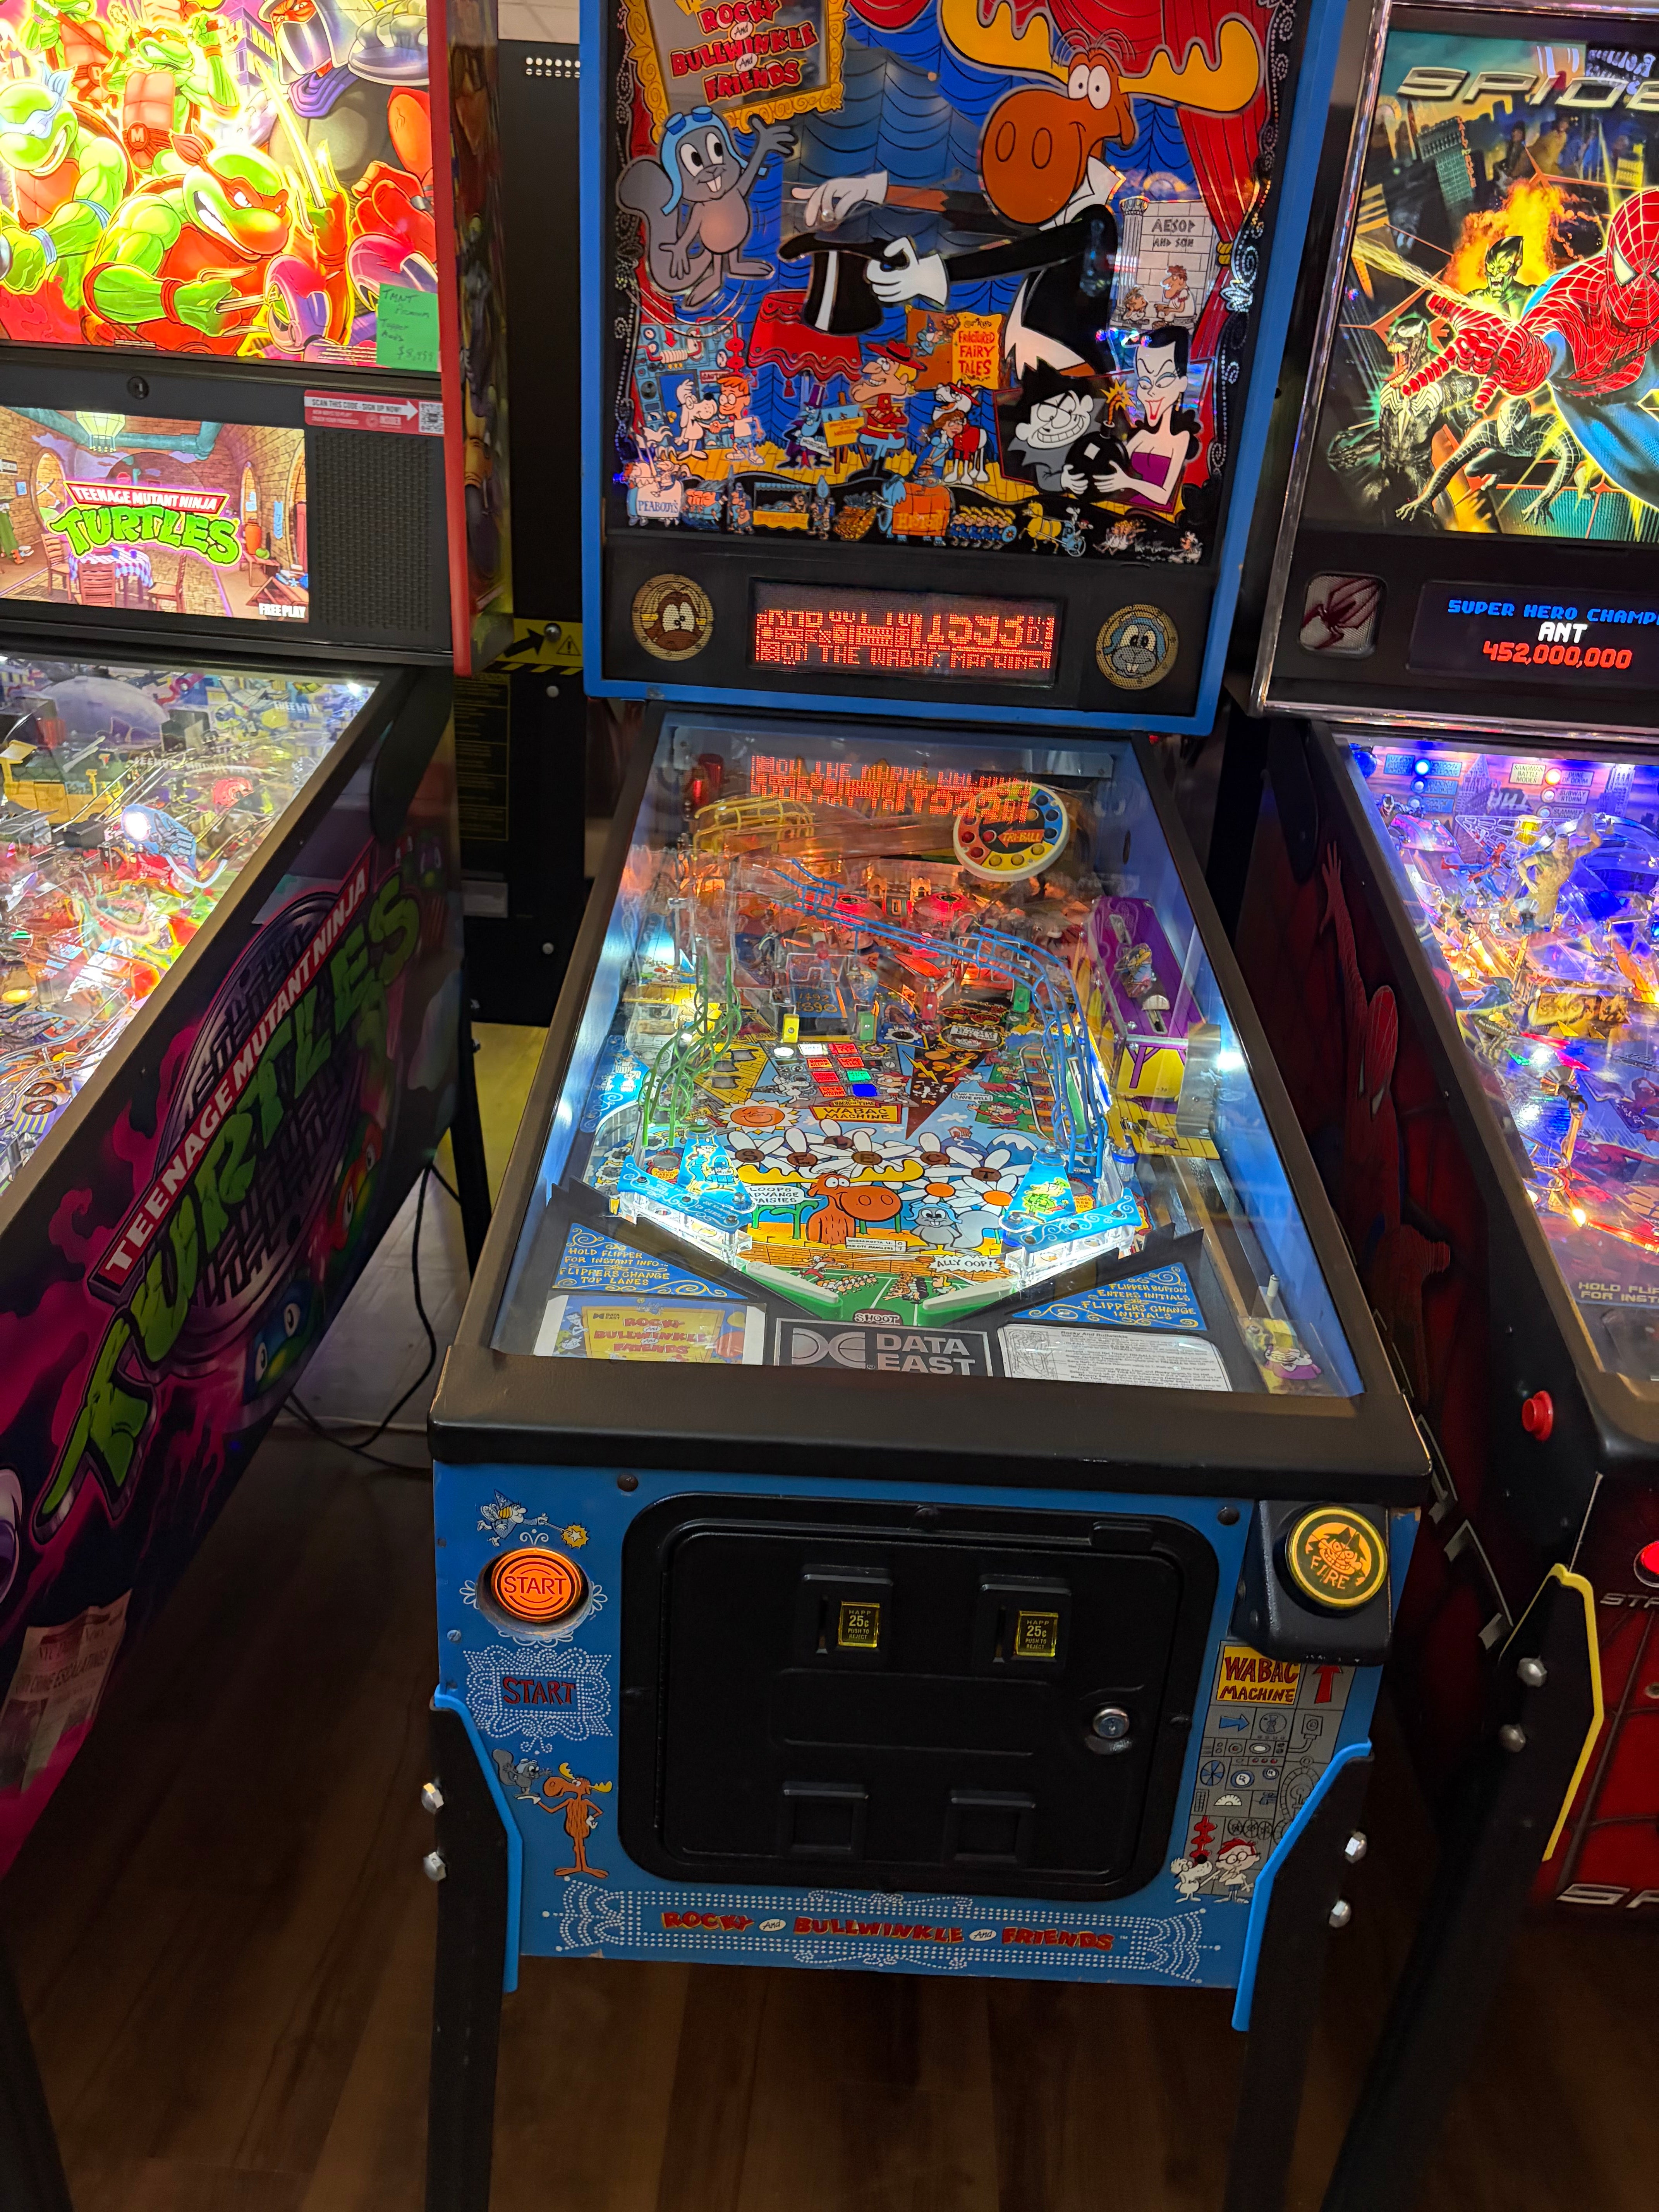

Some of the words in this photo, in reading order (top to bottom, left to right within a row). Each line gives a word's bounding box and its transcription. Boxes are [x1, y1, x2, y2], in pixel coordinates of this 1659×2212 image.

[698, 0, 780, 34] ROCKY
[734, 24, 749, 36] And
[670, 22, 817, 77] BULLWINKLE
[738, 54, 753, 68] And
[704, 60, 800, 103] FRIENDS
[1151, 219, 1195, 232] AESOP
[1153, 237, 1171, 247] AND
[1175, 238, 1194, 247] SON
[958, 359, 991, 376] TALES
[74, 487, 131, 504] TEENAGE
[134, 492, 178, 507] MUTANT
[178, 495, 219, 511] NINJA
[639, 500, 678, 514] PEABODY'S
[49, 505, 239, 564] TURTLES
[259, 603, 282, 616] FREE
[282, 605, 306, 618] PLAY
[1448, 599, 1515, 617] SUPER
[1524, 604, 1577, 620] HERO
[1538, 622, 1588, 643] ANT
[818, 644, 861, 664] THE
[1483, 641, 1632, 670] 452,000,000
[1514, 764, 1544, 772] SANDMAN
[1002, 833, 1041, 842] TRI-BALL
[799, 993, 830, 1002] 1492
[104, 1089, 233, 1272] TEENAGE
[232, 965, 314, 1092] MUTANT
[312, 867, 367, 968] NINJA
[743, 1151, 756, 1161] S
[602, 1250, 642, 1259] FLIPPER
[937, 1259, 961, 1268] ALLY
[559, 1267, 620, 1278] FLIPPERS
[622, 1271, 670, 1279] CHANGE
[1579, 1282, 1620, 1292] HOLD
[1097, 1290, 1140, 1298] ENTERS
[1144, 1292, 1190, 1302] INITIALS
[1581, 1291, 1612, 1300] FOR
[1081, 1301, 1146, 1312] FLIPPERS
[1150, 1305, 1196, 1314] CHANGE
[854, 1313, 900, 1323] SHOOT
[1113, 1311, 1172, 1320] INITIALS
[623, 1318, 685, 1329] ROCKY
[594, 1330, 708, 1342] BULLWINKLE
[614, 1343, 691, 1354] FRIENDS
[877, 1333, 970, 1355] DATA
[877, 1353, 975, 1376] EAST
[1310, 1555, 1350, 1589] FIRE
[504, 1576, 566, 1595] START
[1224, 1656, 1300, 1684] WABAC
[503, 1677, 576, 1705] START
[1219, 1685, 1295, 1702] MACHINE
[661, 1912, 754, 1932] ROCKY
[762, 1920, 783, 1930] And
[793, 1917, 964, 1943] BULLWINKLE
[973, 1929, 993, 1940] And
[1001, 1927, 1114, 1951] FRIENDS
